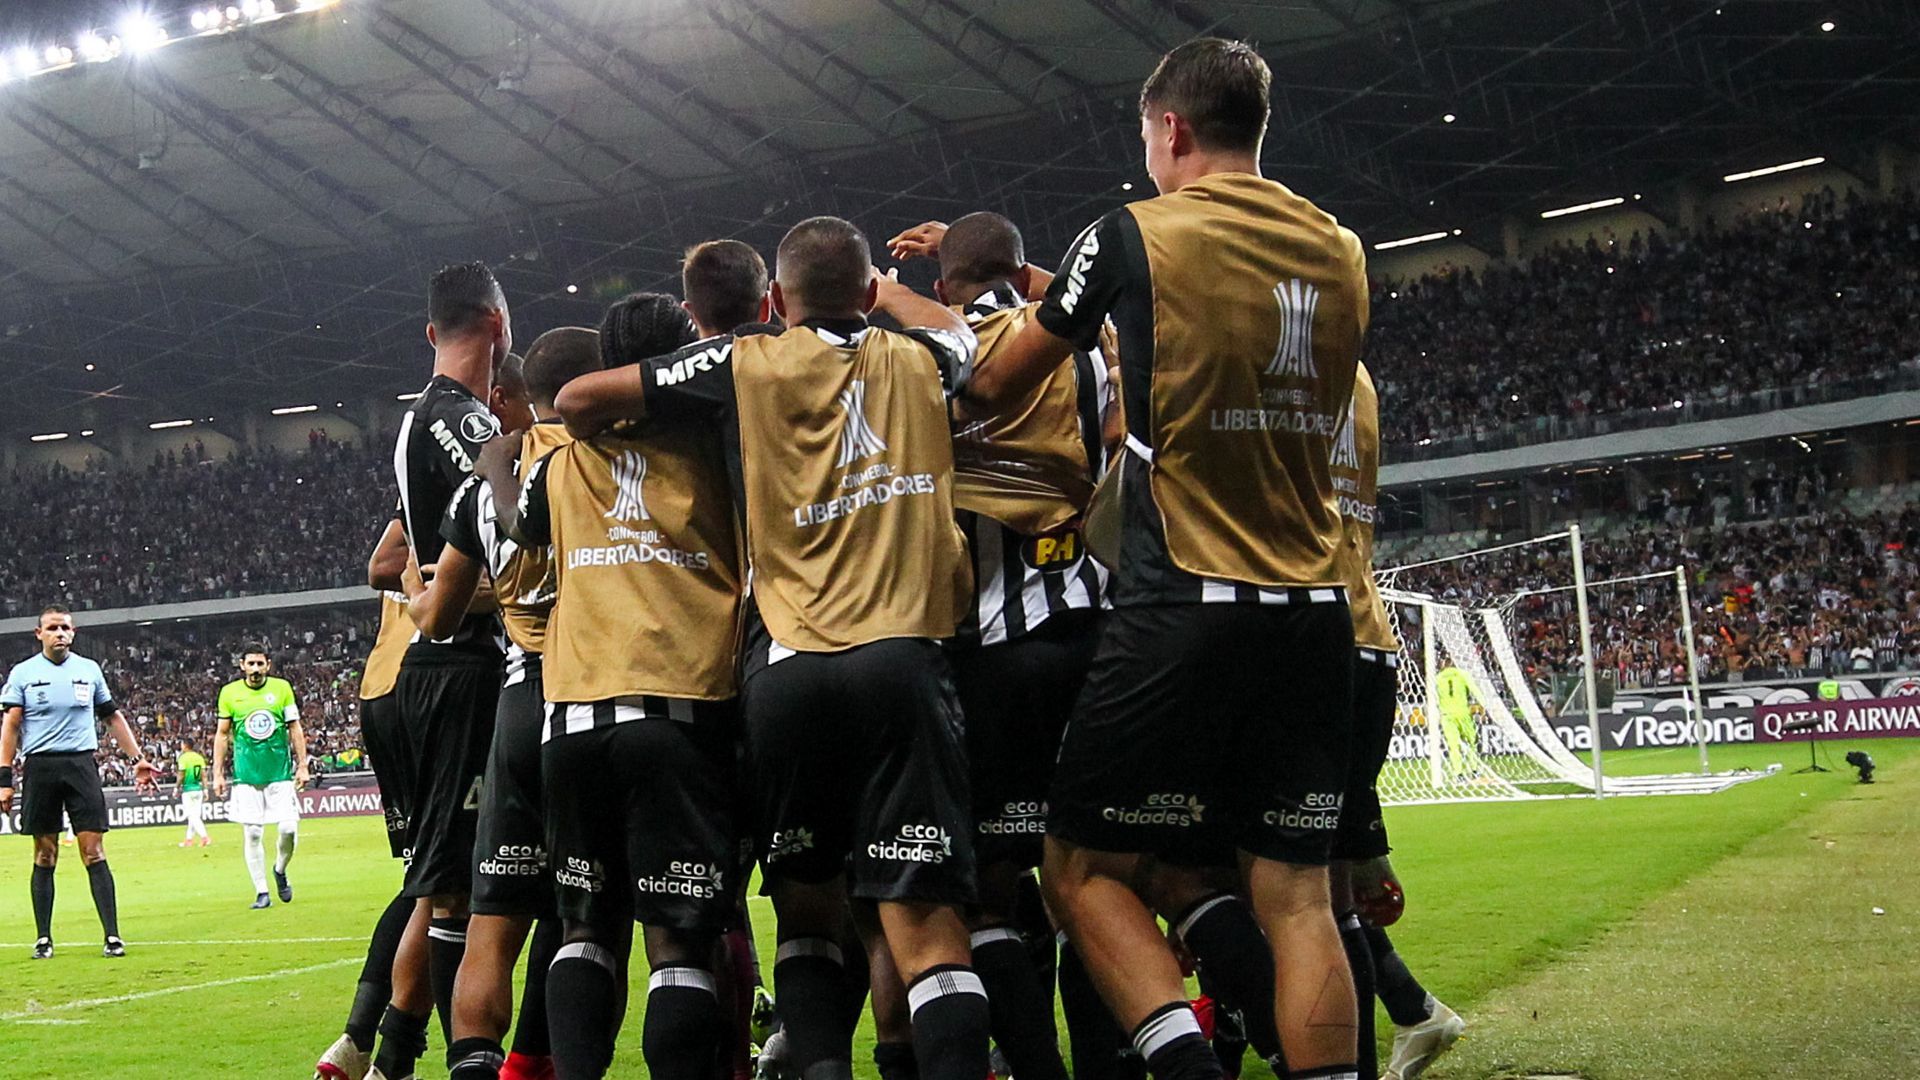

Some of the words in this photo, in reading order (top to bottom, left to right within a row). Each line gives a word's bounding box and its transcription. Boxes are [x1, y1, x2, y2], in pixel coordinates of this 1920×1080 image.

[1060, 227, 1099, 315] MRV
[656, 343, 732, 386] MRV
[1210, 408, 1334, 436] LIBERTADORE
[429, 418, 474, 473] MRV
[794, 473, 935, 527] LIBERTADORES
[568, 543, 709, 569] LIBERTADORES
[1635, 716, 1754, 746] Rexona
[318, 793, 382, 815] AIRWAY
[1004, 801, 1038, 815] eco
[1148, 793, 1185, 806] eco
[1305, 791, 1334, 807] eco
[108, 800, 231, 826] LIBERTADRES
[1102, 807, 1190, 827] cidades
[1263, 809, 1338, 830] cidades
[901, 825, 938, 840] eco
[979, 819, 1047, 835] cidades
[498, 844, 532, 857] eco
[867, 841, 944, 864] cidades
[479, 859, 540, 876] cidades
[567, 856, 590, 872] eco
[670, 860, 707, 876] eco
[556, 868, 603, 892] cidades
[637, 877, 714, 899] cidades
